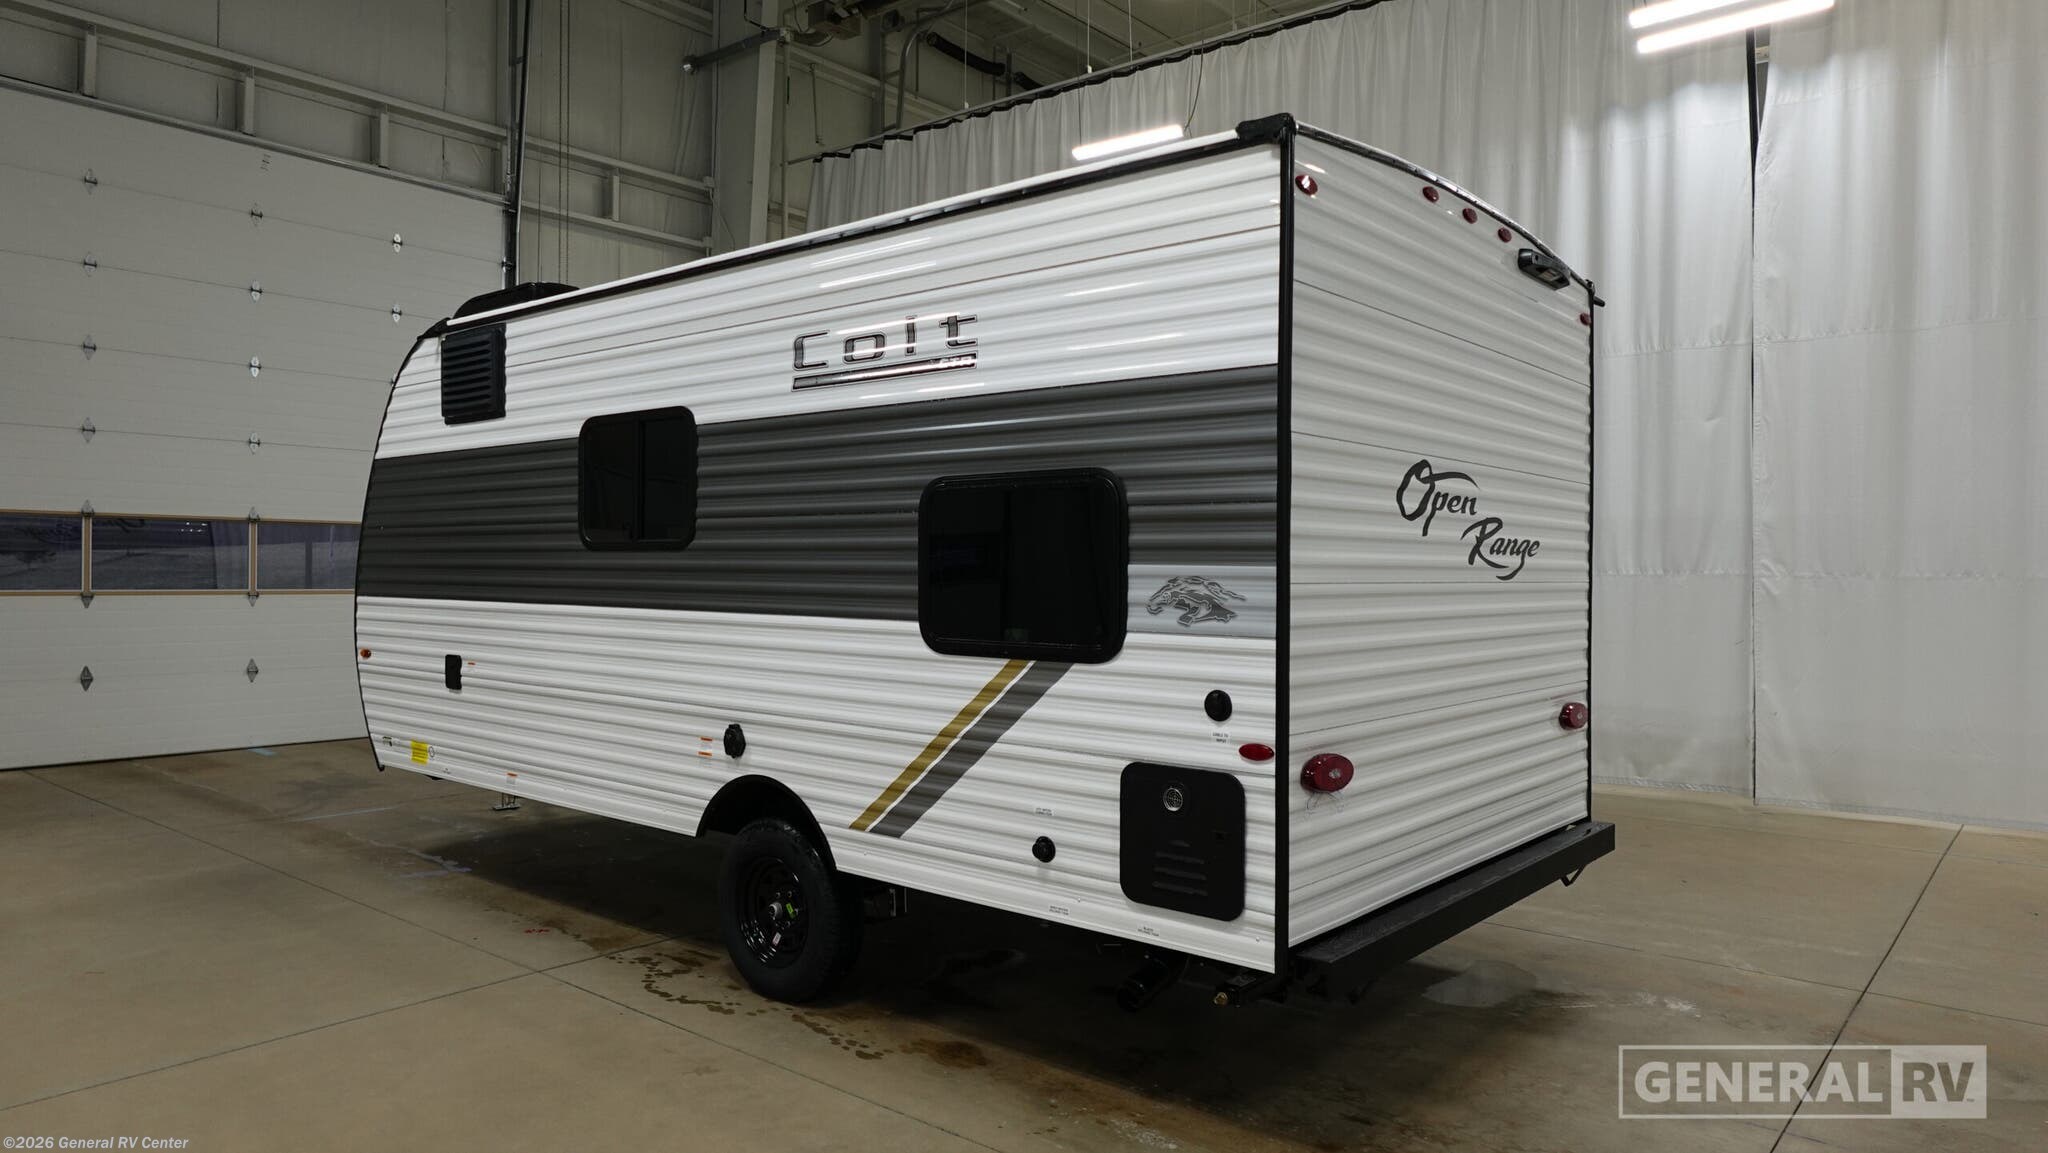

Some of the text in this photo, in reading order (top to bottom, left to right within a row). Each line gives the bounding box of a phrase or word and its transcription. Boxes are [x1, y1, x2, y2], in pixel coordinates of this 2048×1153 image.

[793, 314, 978, 371] Colt
[1396, 459, 1480, 537] Open
[1460, 517, 1541, 581] Range
